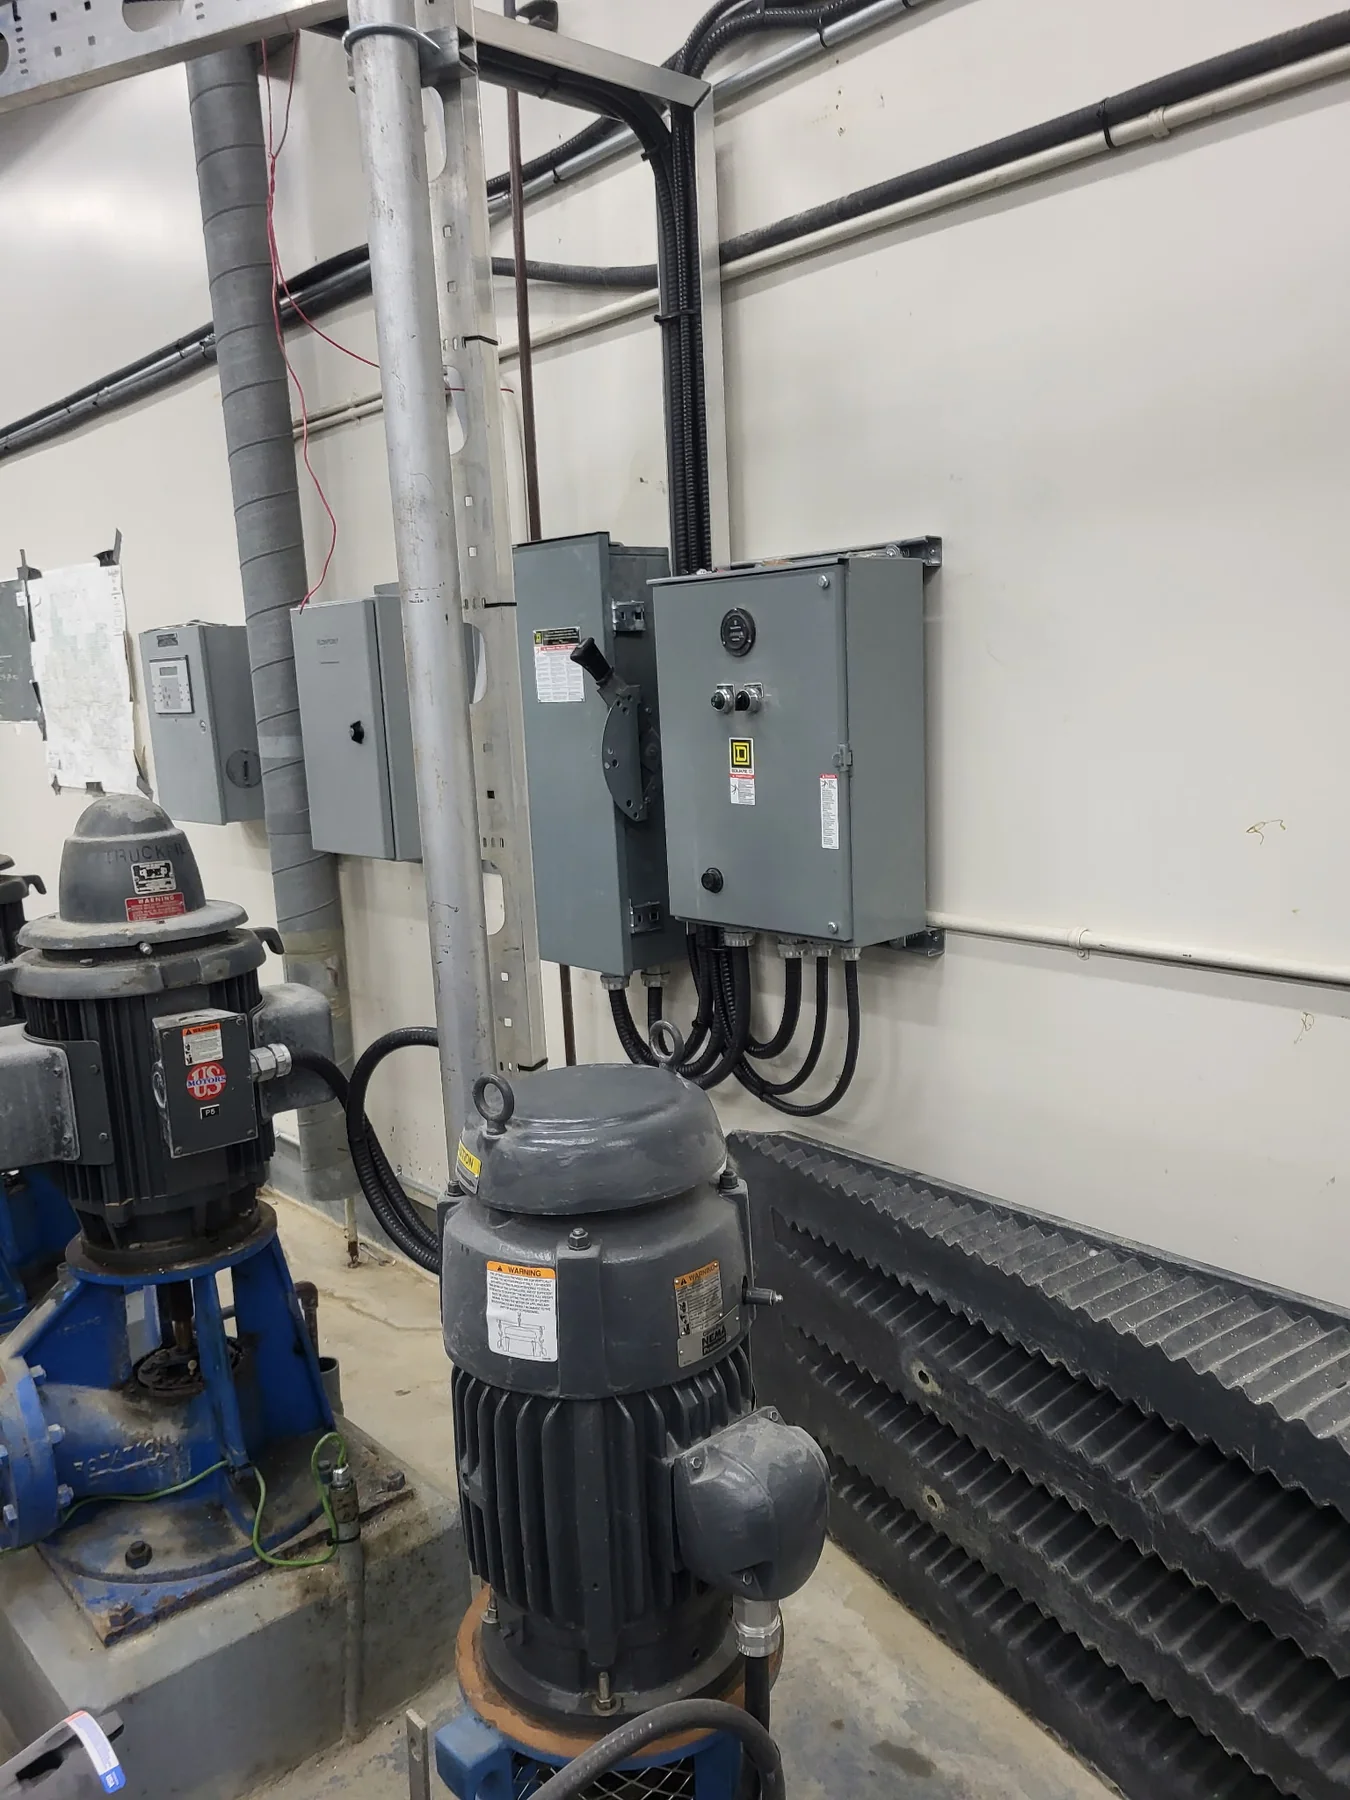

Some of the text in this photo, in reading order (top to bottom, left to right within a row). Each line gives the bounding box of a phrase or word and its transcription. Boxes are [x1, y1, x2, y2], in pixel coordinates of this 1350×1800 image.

[137, 895, 175, 904] WARNING
[192, 1024, 218, 1034] WARNING
[187, 1075, 227, 1088] MOTORS
[191, 1065, 222, 1098] US
[507, 1266, 542, 1277] WARNING
[701, 1325, 727, 1347] NEMA
